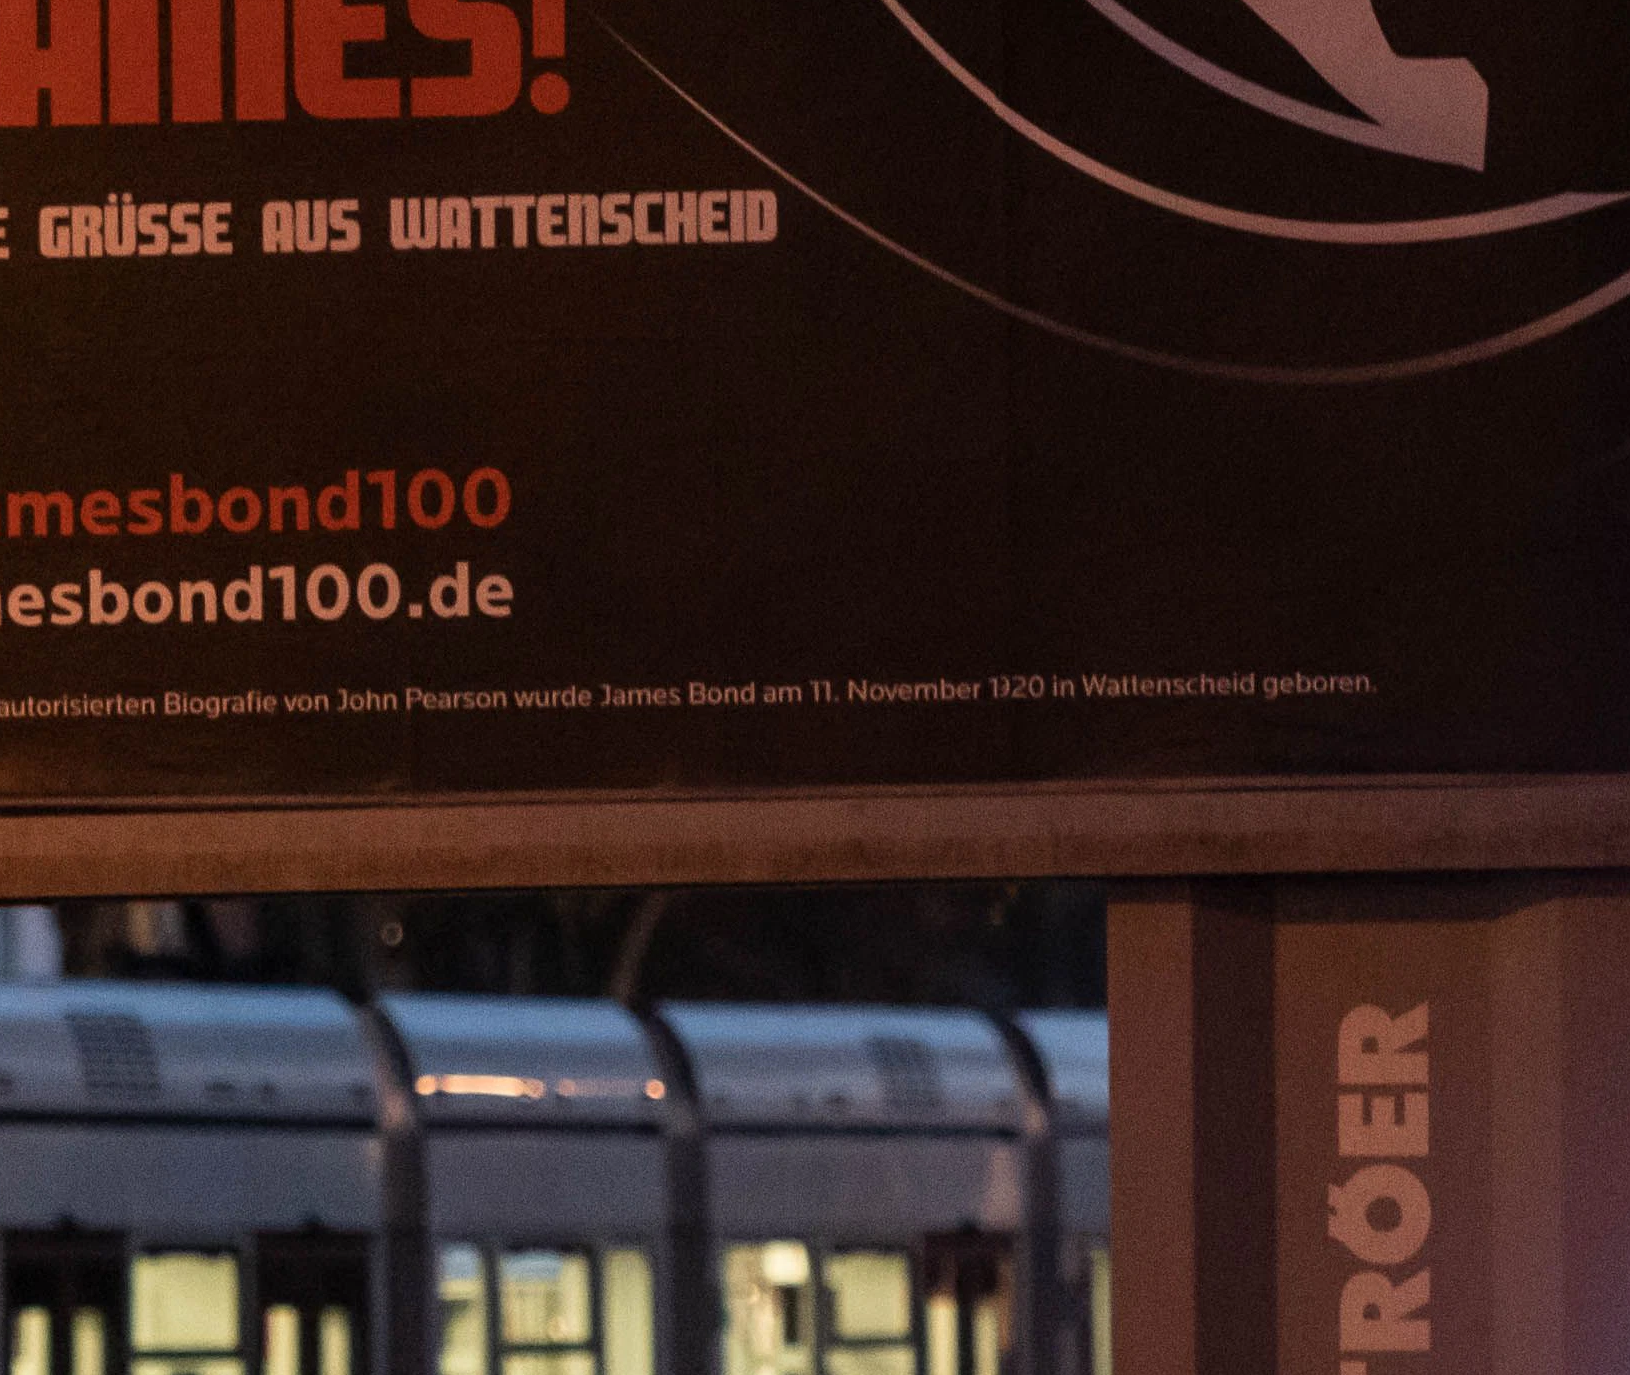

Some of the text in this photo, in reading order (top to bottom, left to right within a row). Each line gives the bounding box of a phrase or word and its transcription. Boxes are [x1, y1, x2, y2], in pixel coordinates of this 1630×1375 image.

[38, 193, 233, 258] GRÜSSE
[262, 199, 361, 253] AUS
[389, 190, 778, 250] WATTENSCHEID
[163, 690, 278, 719] Biografie
[283, 694, 330, 712] von
[338, 688, 398, 712] John
[404, 687, 508, 711] Pearson
[513, 685, 592, 708] wurde
[601, 684, 681, 706] James
[688, 681, 756, 705] Bond
[763, 685, 803, 704] am
[811, 680, 838, 702] 11.
[847, 678, 981, 702] November
[1052, 675, 1076, 697] in
[1081, 673, 1256, 697] Wattenscheid
[1262, 671, 1378, 700] geboren.
[1327, 1004, 1432, 1375] RÖER
